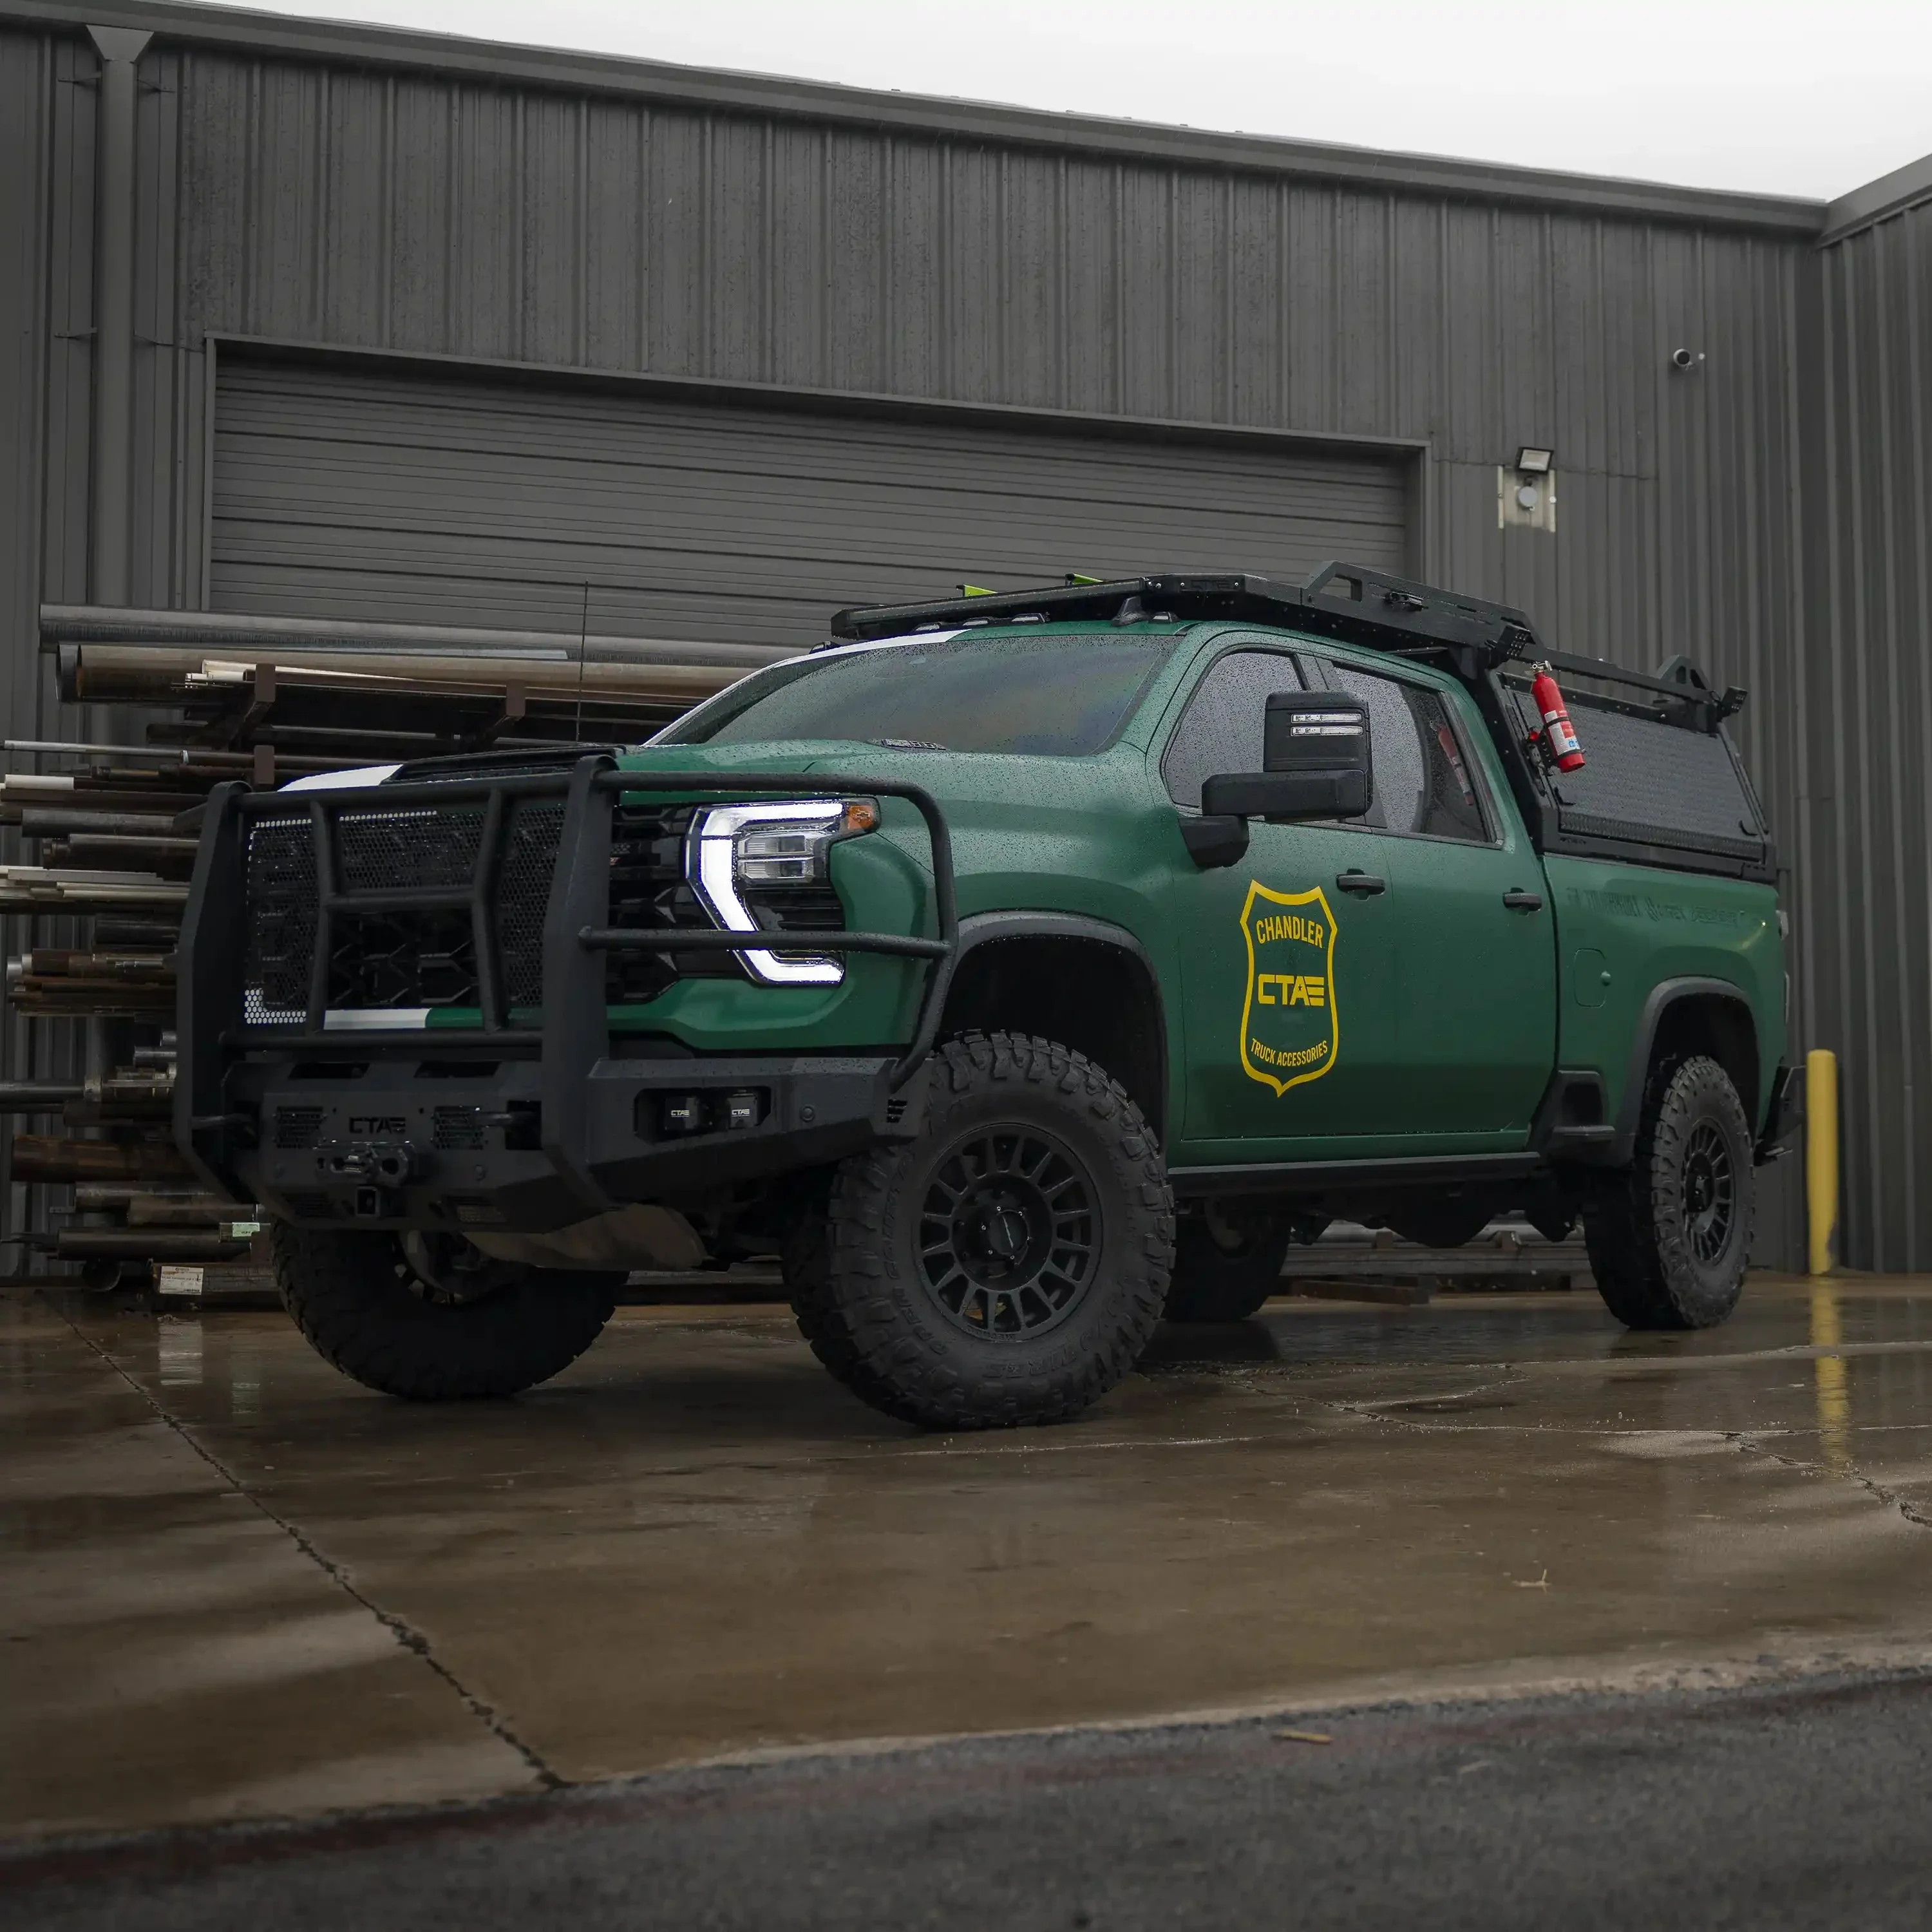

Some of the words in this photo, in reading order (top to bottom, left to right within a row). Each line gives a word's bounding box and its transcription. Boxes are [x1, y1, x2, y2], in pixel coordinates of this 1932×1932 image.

[1256, 916, 1323, 948] CHANDLER
[1258, 974, 1324, 1006] CTAE
[1251, 1038, 1275, 1064] TRUCK
[1276, 1040, 1328, 1066] ACCESSORIES
